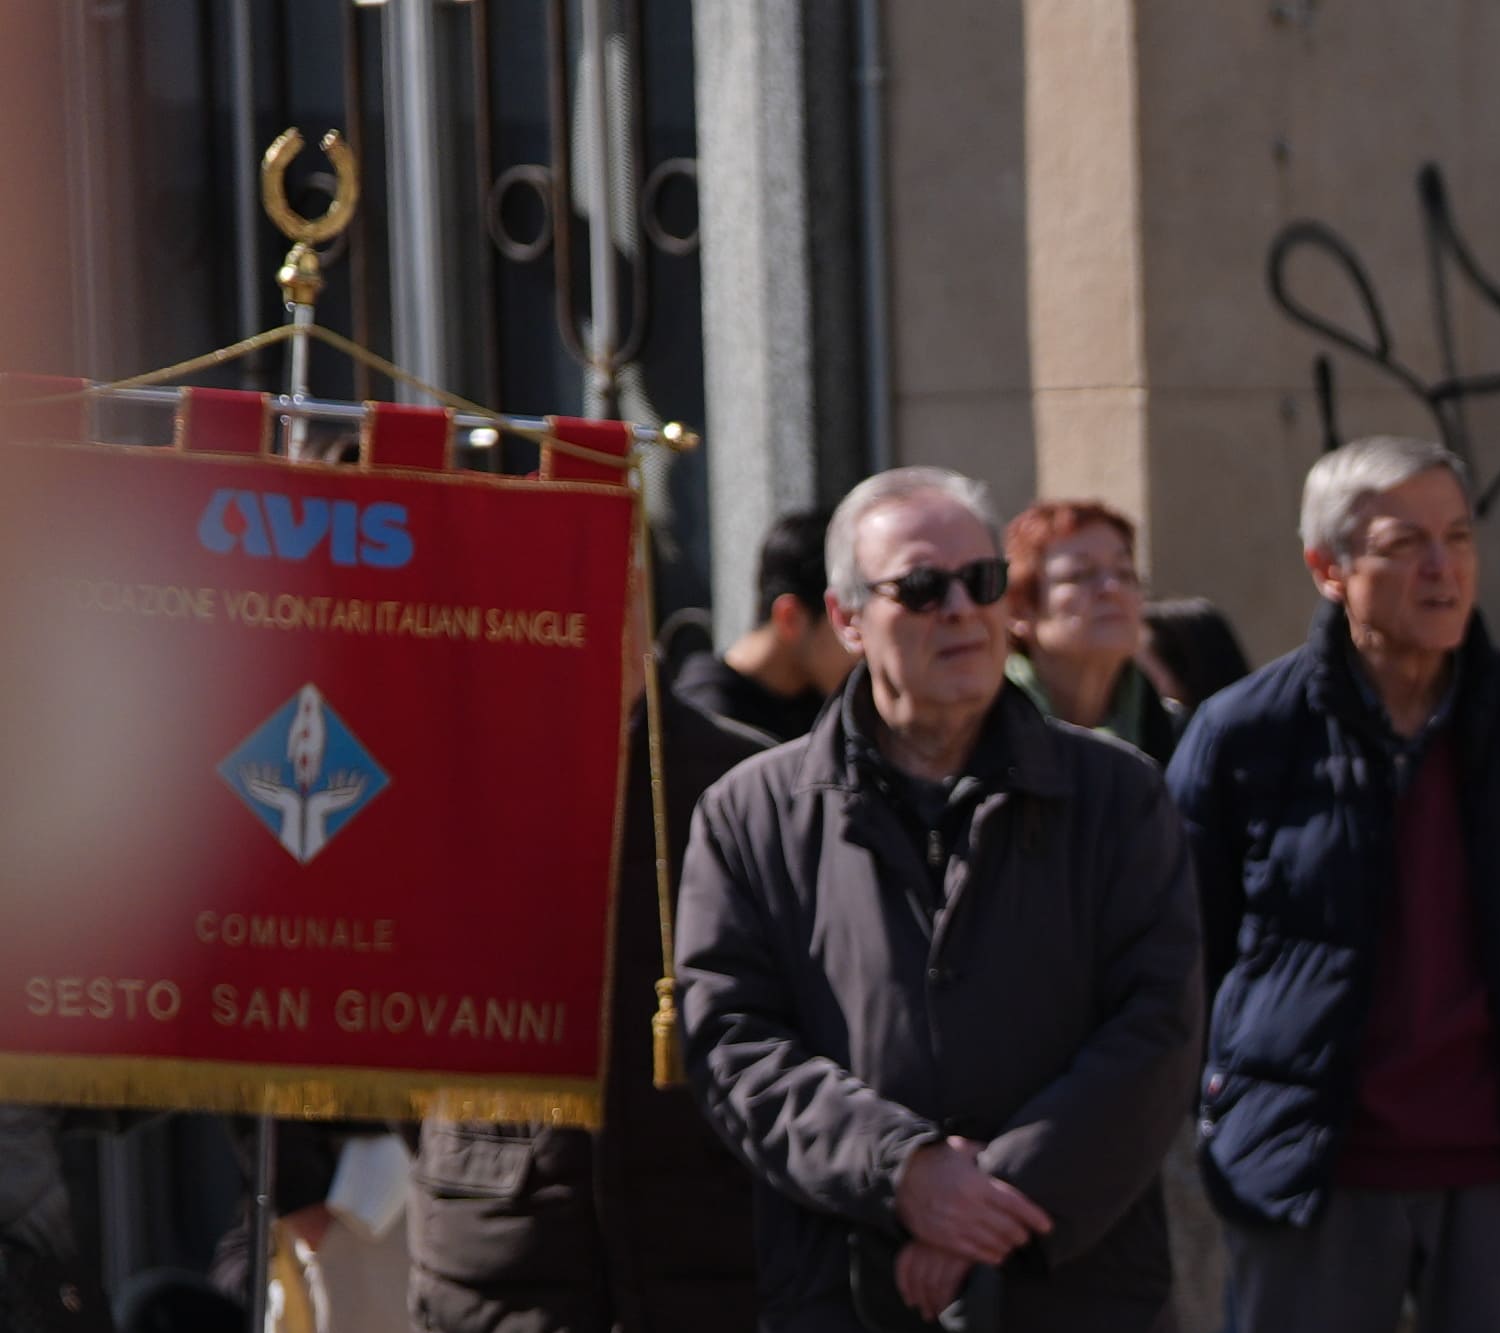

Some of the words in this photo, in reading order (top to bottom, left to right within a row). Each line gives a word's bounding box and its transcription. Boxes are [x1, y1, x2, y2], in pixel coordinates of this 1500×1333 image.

[199, 486, 414, 569] AVIS
[50, 575, 217, 623] OCIAZIONE
[223, 589, 370, 635] VOLONTARI
[375, 599, 480, 641] ITALIANI
[485, 607, 587, 649] SANGUE
[194, 910, 398, 953] COMUNALE
[24, 975, 183, 1022] SESTO
[211, 983, 311, 1030] SAN
[334, 989, 567, 1045] GIOVANNI
